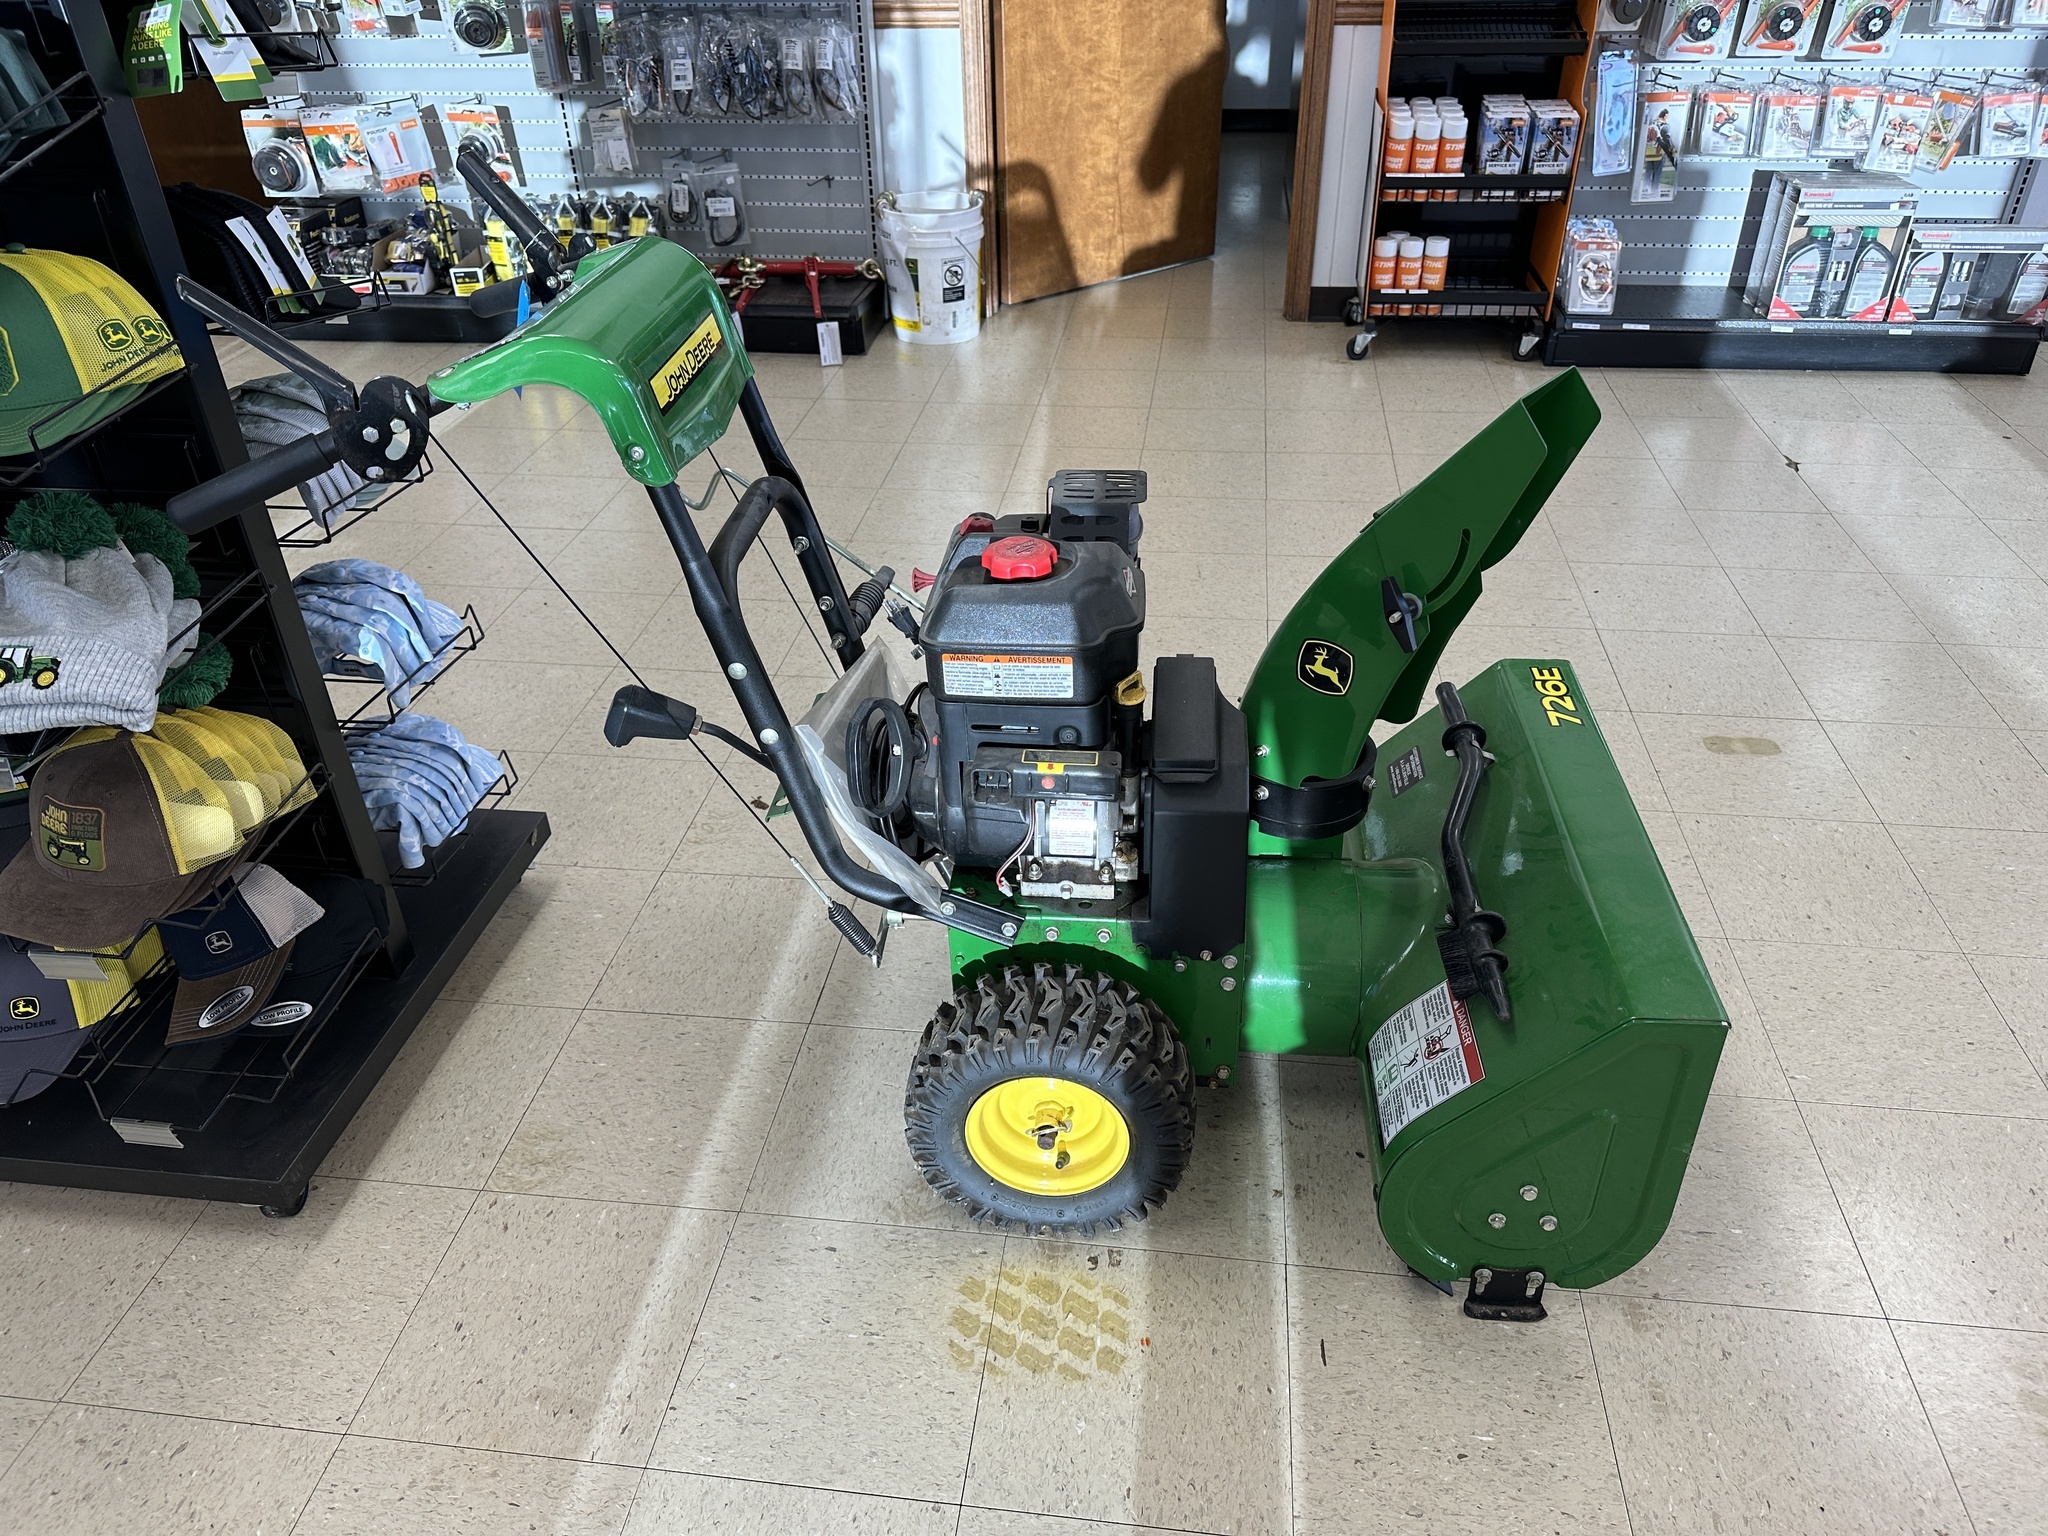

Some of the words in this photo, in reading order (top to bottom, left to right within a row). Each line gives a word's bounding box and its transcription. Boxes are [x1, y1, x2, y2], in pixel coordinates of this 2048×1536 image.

[132, 31, 153, 42] RUNS
[154, 28, 172, 38] LIKE
[139, 40, 165, 49] DEERE
[101, 356, 127, 373] JOHN
[664, 359, 692, 399] JOHN
[685, 331, 716, 372] DEERE
[949, 655, 984, 663] WARNING
[1530, 666, 1585, 727] 726E
[45, 804, 68, 823] JOHN
[72, 812, 98, 825] 1837
[41, 812, 68, 837] DEERE
[205, 1009, 221, 1021] LOW
[220, 991, 245, 1011] PROFILE
[259, 1012, 276, 1021] LOW
[276, 1006, 304, 1017] PROFILE
[25, 1018, 57, 1029] DEERE
[1455, 1007, 1473, 1047] DANGER
